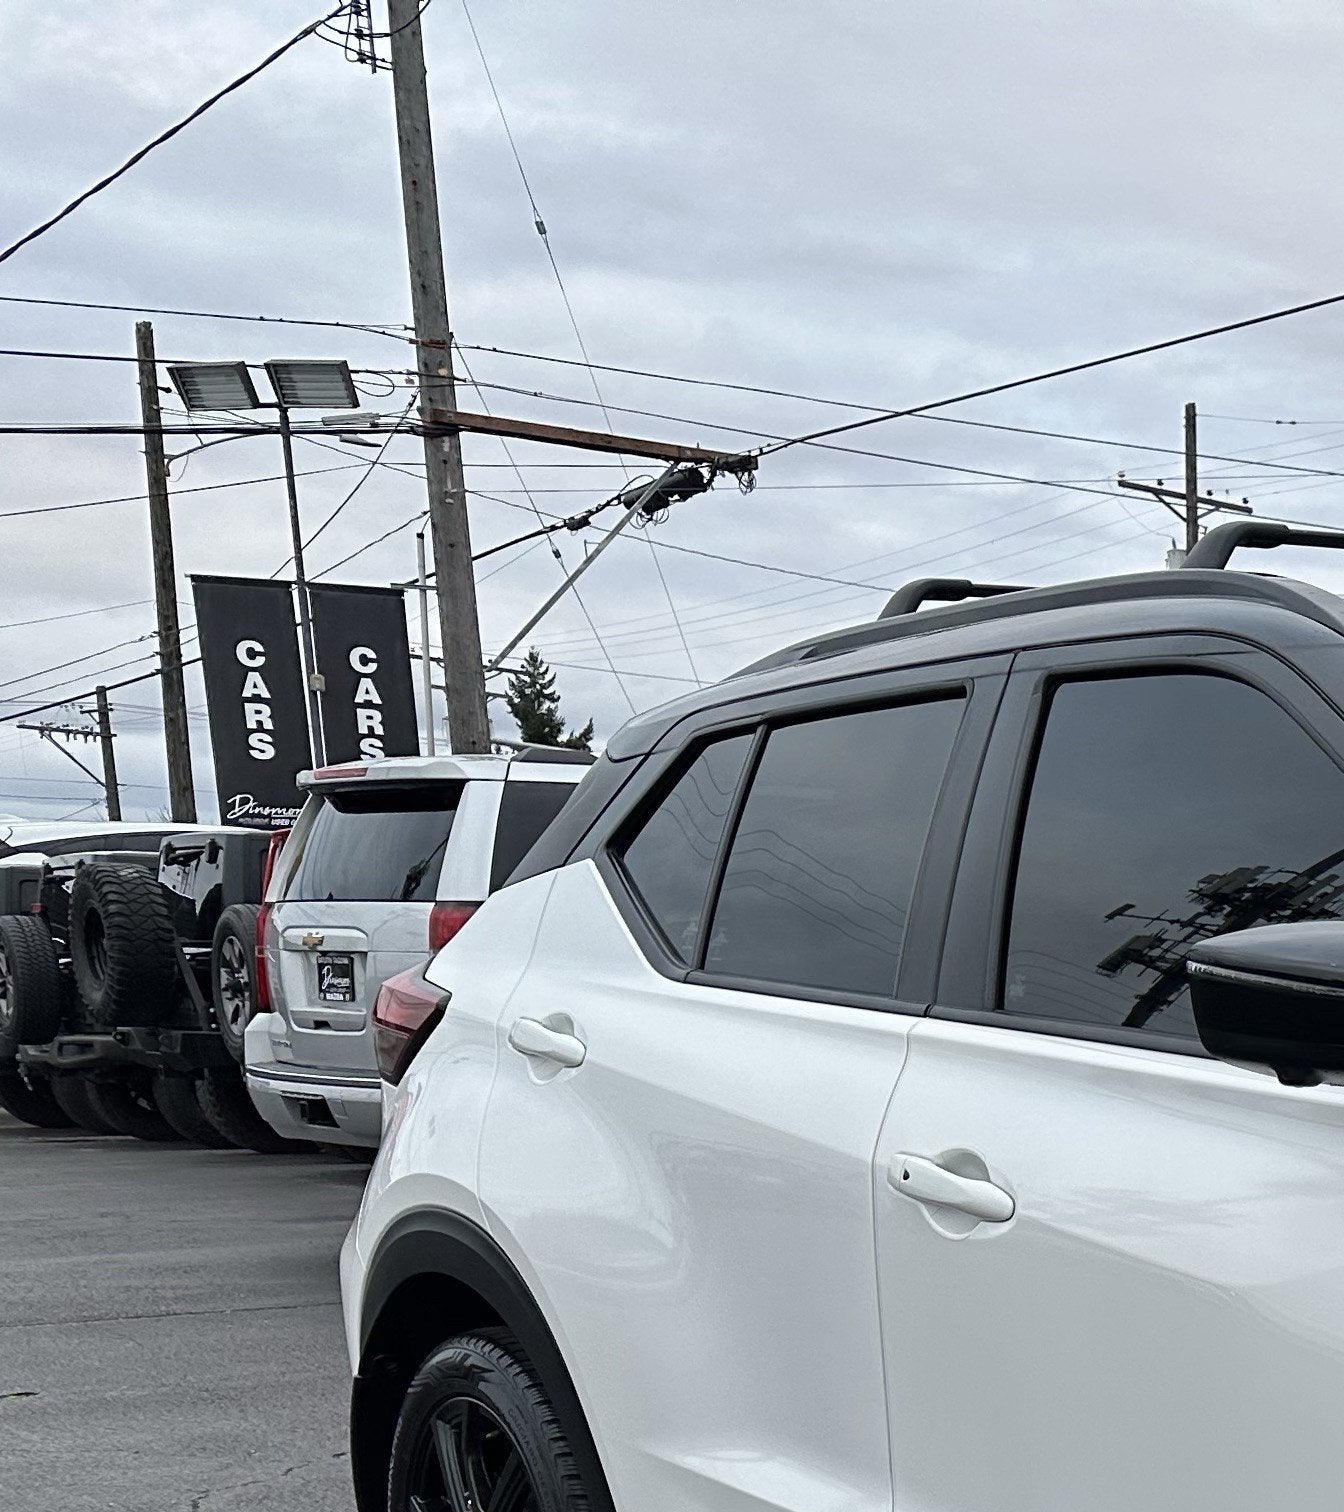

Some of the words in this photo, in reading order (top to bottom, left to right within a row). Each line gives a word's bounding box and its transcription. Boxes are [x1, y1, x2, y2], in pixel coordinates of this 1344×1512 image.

[235, 639, 276, 761] CARS
[349, 646, 386, 761] CARS
[226, 793, 302, 819] Dinsmor
